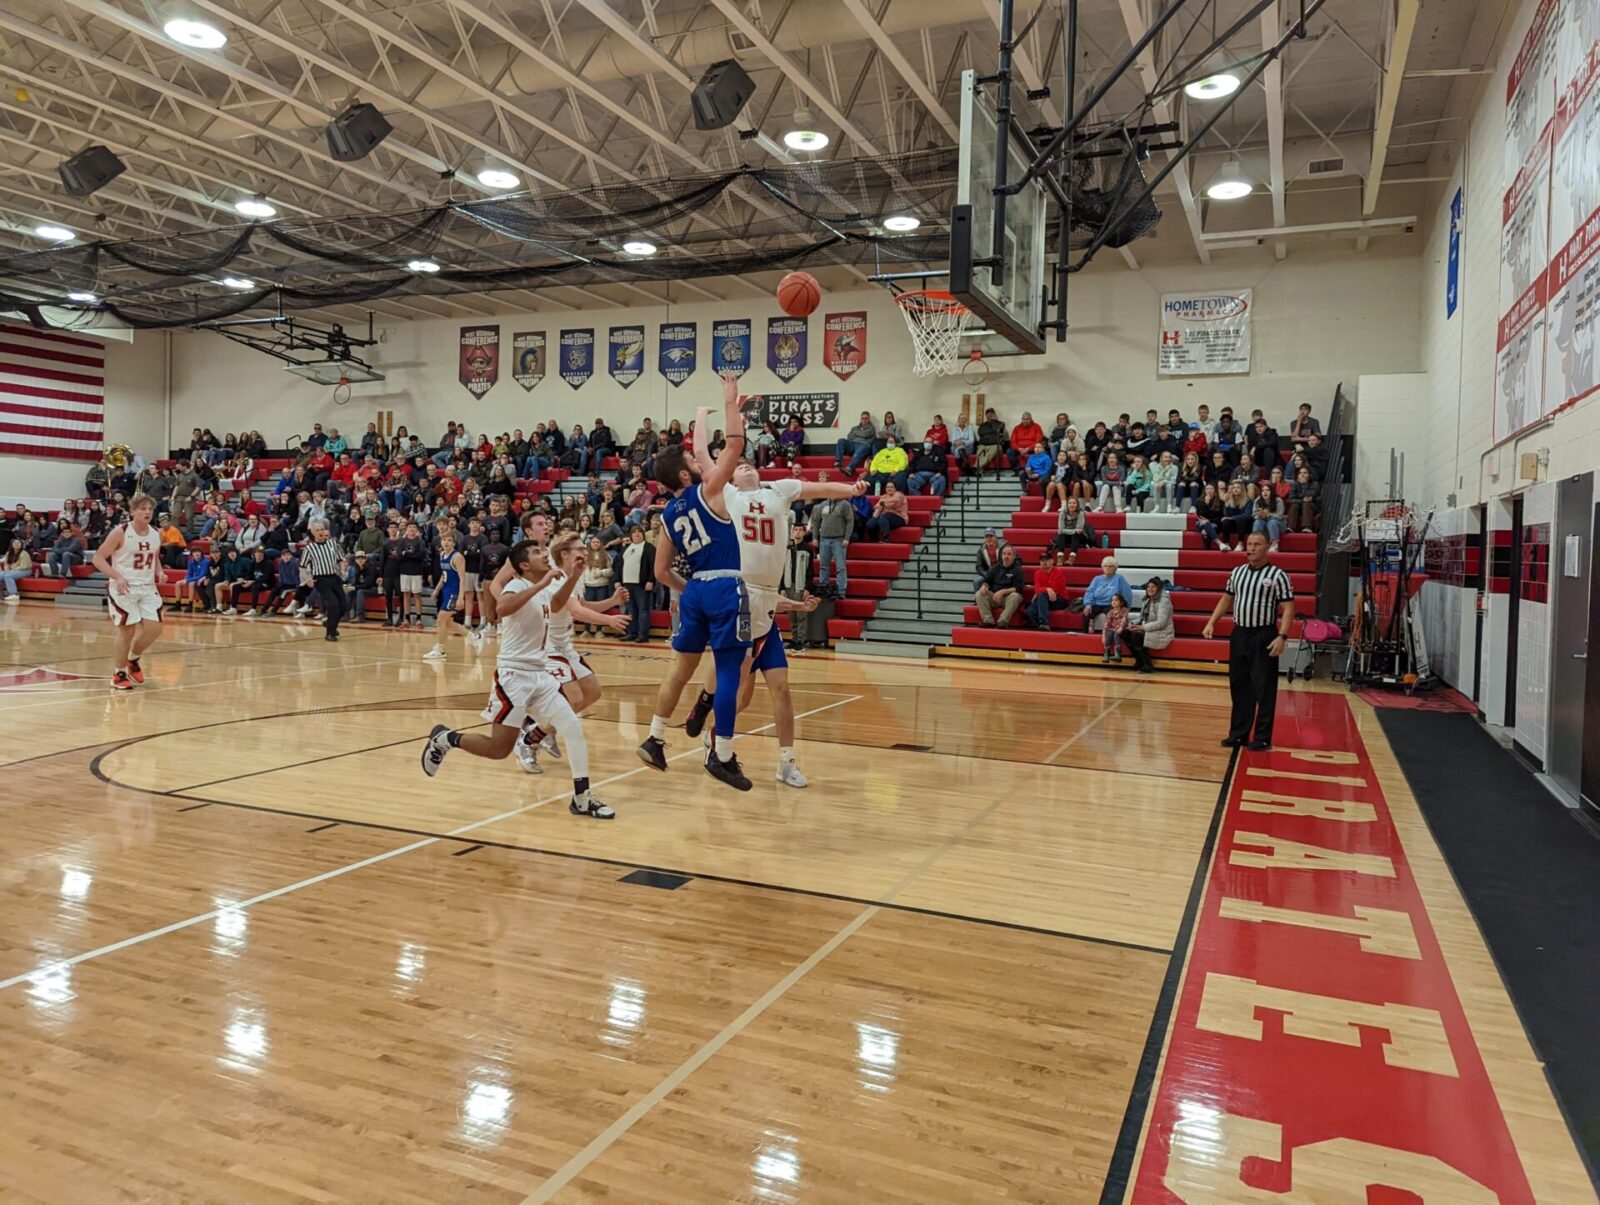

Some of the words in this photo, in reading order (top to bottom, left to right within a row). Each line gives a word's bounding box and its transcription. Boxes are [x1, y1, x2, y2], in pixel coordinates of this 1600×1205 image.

[769, 324, 806, 334] CONFERENCE
[826, 320, 866, 331] CONFERENCE
[660, 331, 695, 340] CONFERENCE
[714, 328, 750, 338] CONFERENCE
[461, 335, 498, 346] CONFERENCE
[775, 367, 798, 378] TIGERS
[831, 364, 858, 375] VIKINGS
[666, 371, 689, 382] EAGLES
[467, 382, 492, 394] PIRATES
[769, 399, 836, 413] PIRATE
[769, 412, 825, 425] POSE
[750, 502, 765, 514] H
[673, 508, 712, 556] 21
[741, 514, 776, 546] 50
[134, 553, 154, 570] 24
